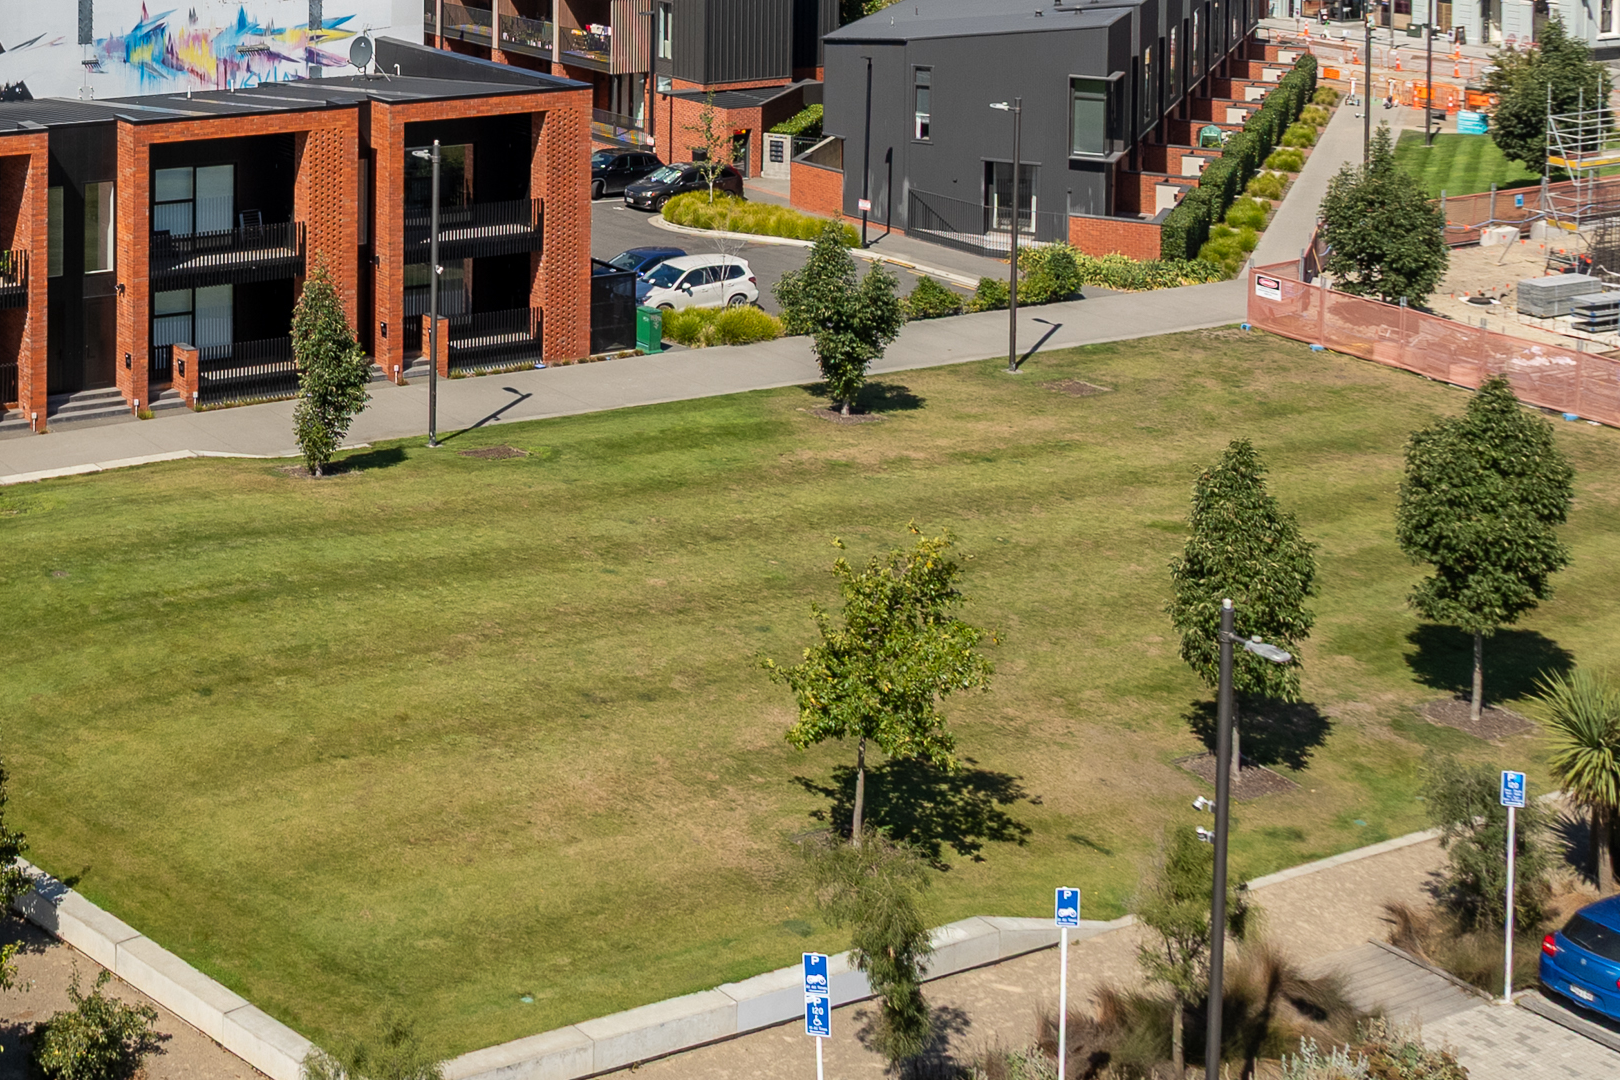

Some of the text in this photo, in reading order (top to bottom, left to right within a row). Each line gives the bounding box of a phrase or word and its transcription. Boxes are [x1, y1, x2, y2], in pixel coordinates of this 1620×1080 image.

[1064, 891, 1072, 899] P
[811, 956, 819, 965] P
[814, 998, 821, 1006] P
[812, 1007, 824, 1015] 120
